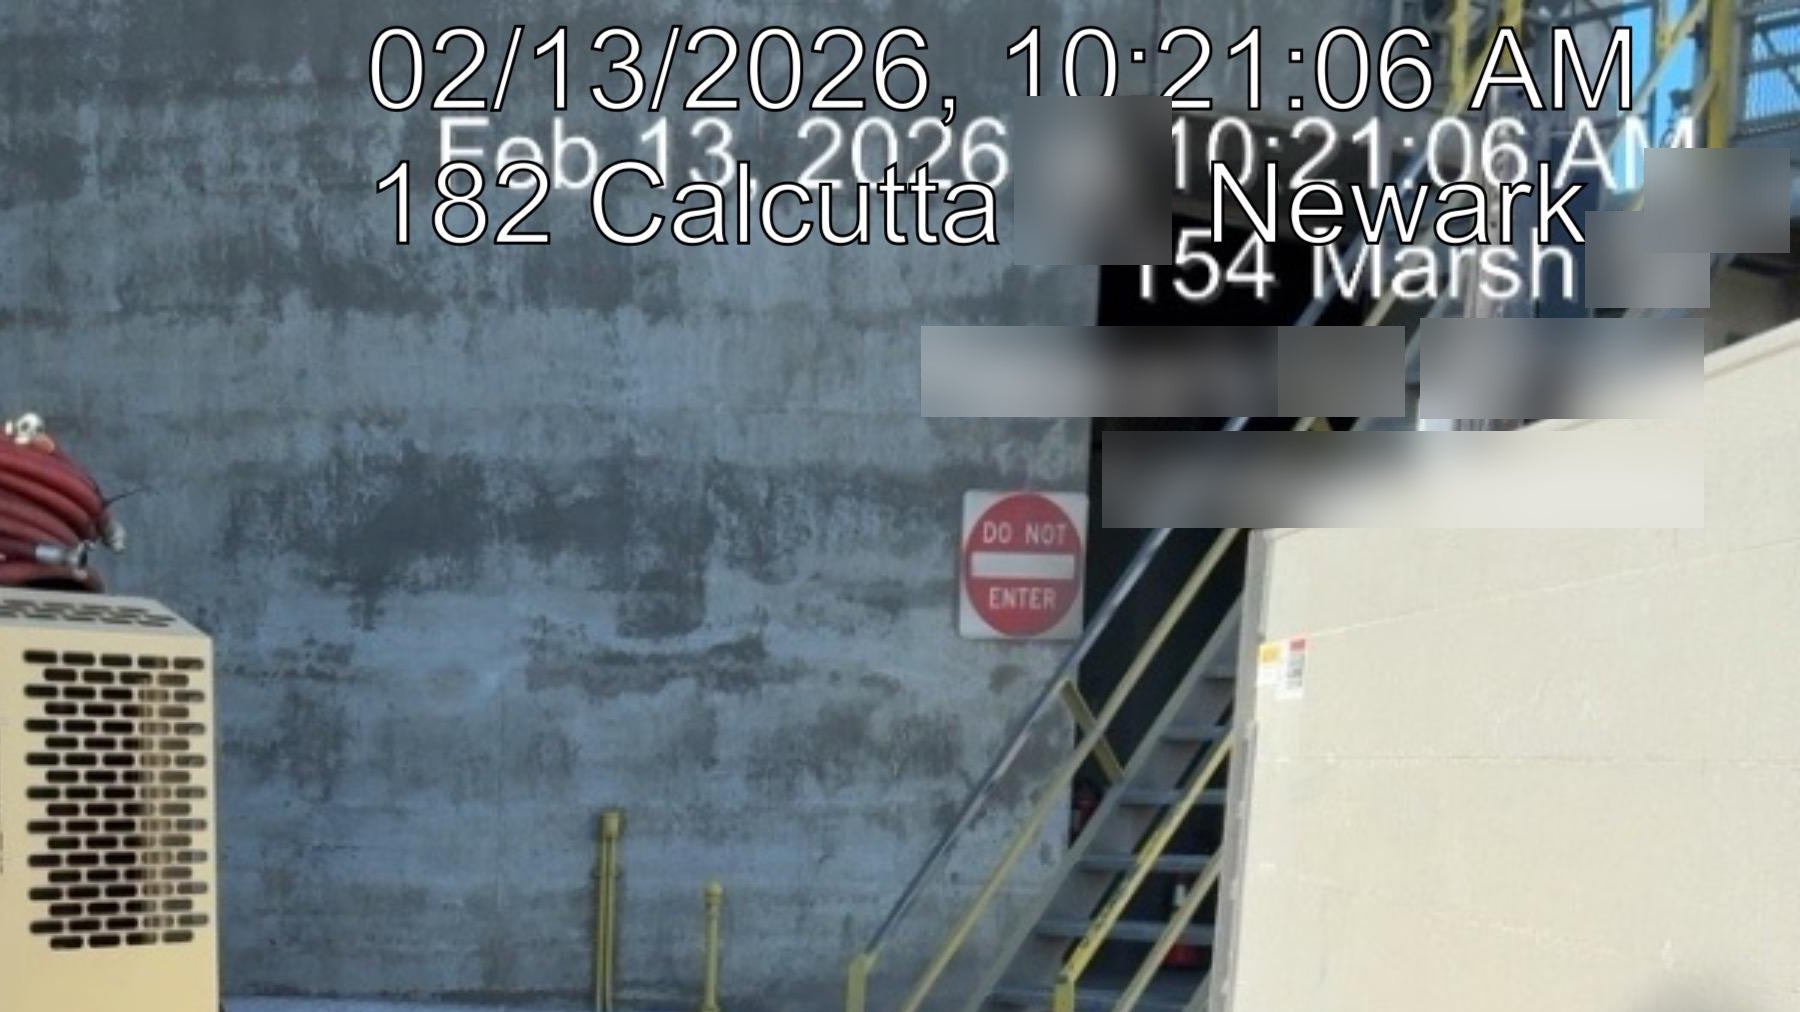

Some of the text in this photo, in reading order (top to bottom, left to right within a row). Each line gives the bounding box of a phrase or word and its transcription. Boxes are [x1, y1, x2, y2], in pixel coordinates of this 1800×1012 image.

[983, 520, 1067, 546] DO NOT
[988, 586, 1057, 611] ENTER
